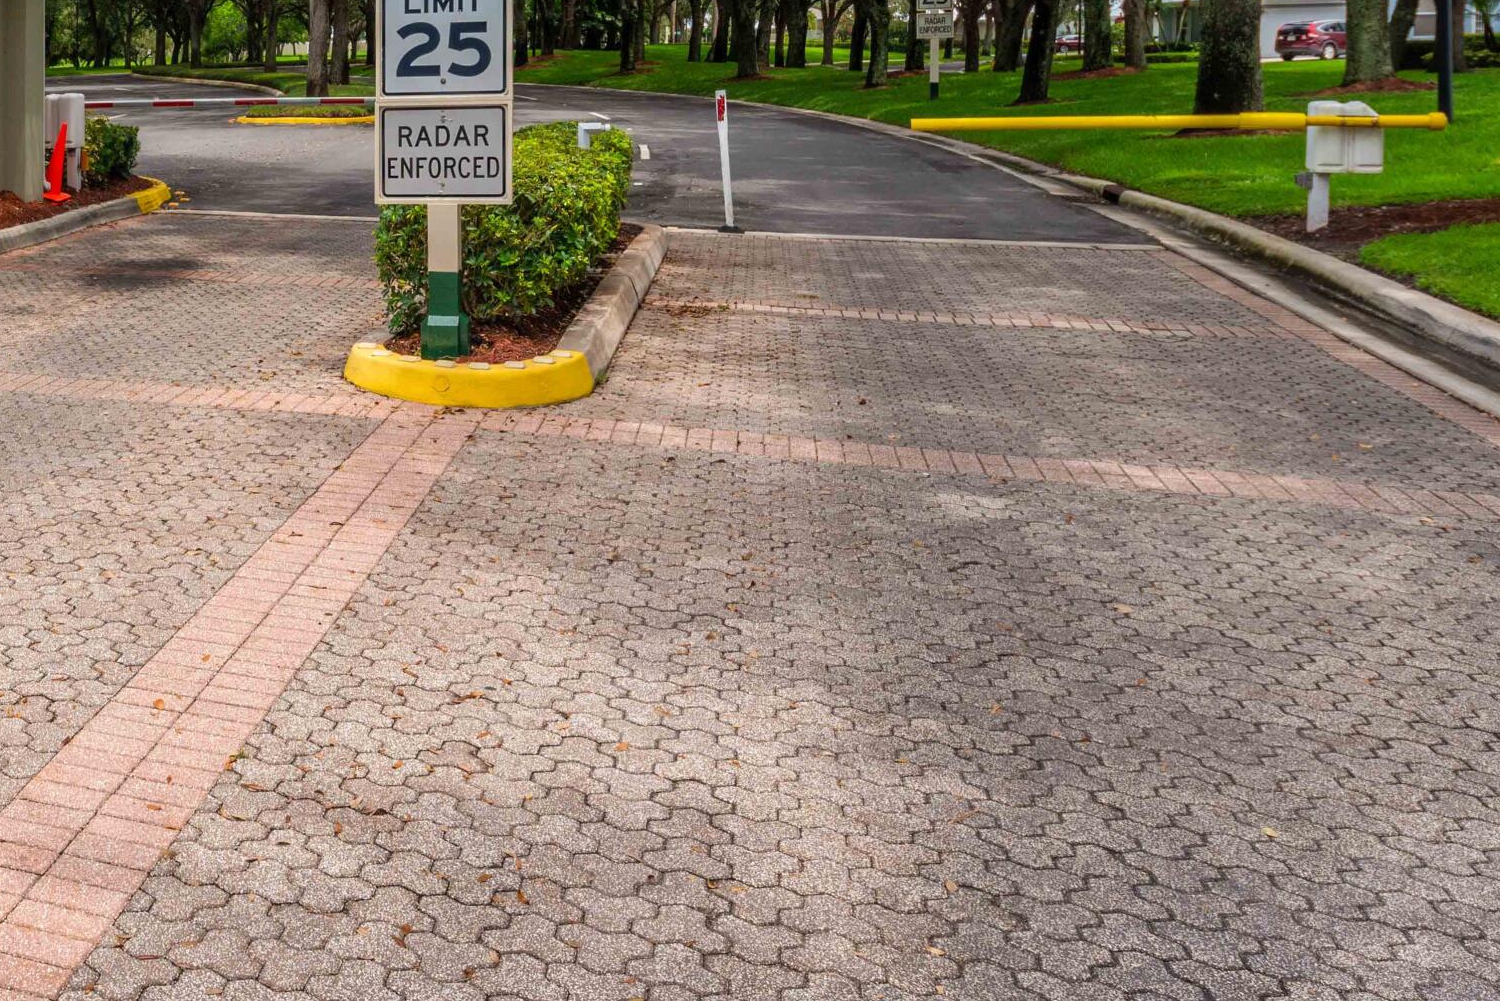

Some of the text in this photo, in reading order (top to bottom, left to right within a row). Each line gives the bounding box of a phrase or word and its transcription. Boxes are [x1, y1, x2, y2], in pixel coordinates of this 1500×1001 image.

[920, 26, 951, 34] ENFORCED
[925, 17, 946, 25] RADAR
[396, 21, 492, 77] 25
[398, 125, 489, 147] RADAR
[388, 157, 500, 179] ENFORCED
